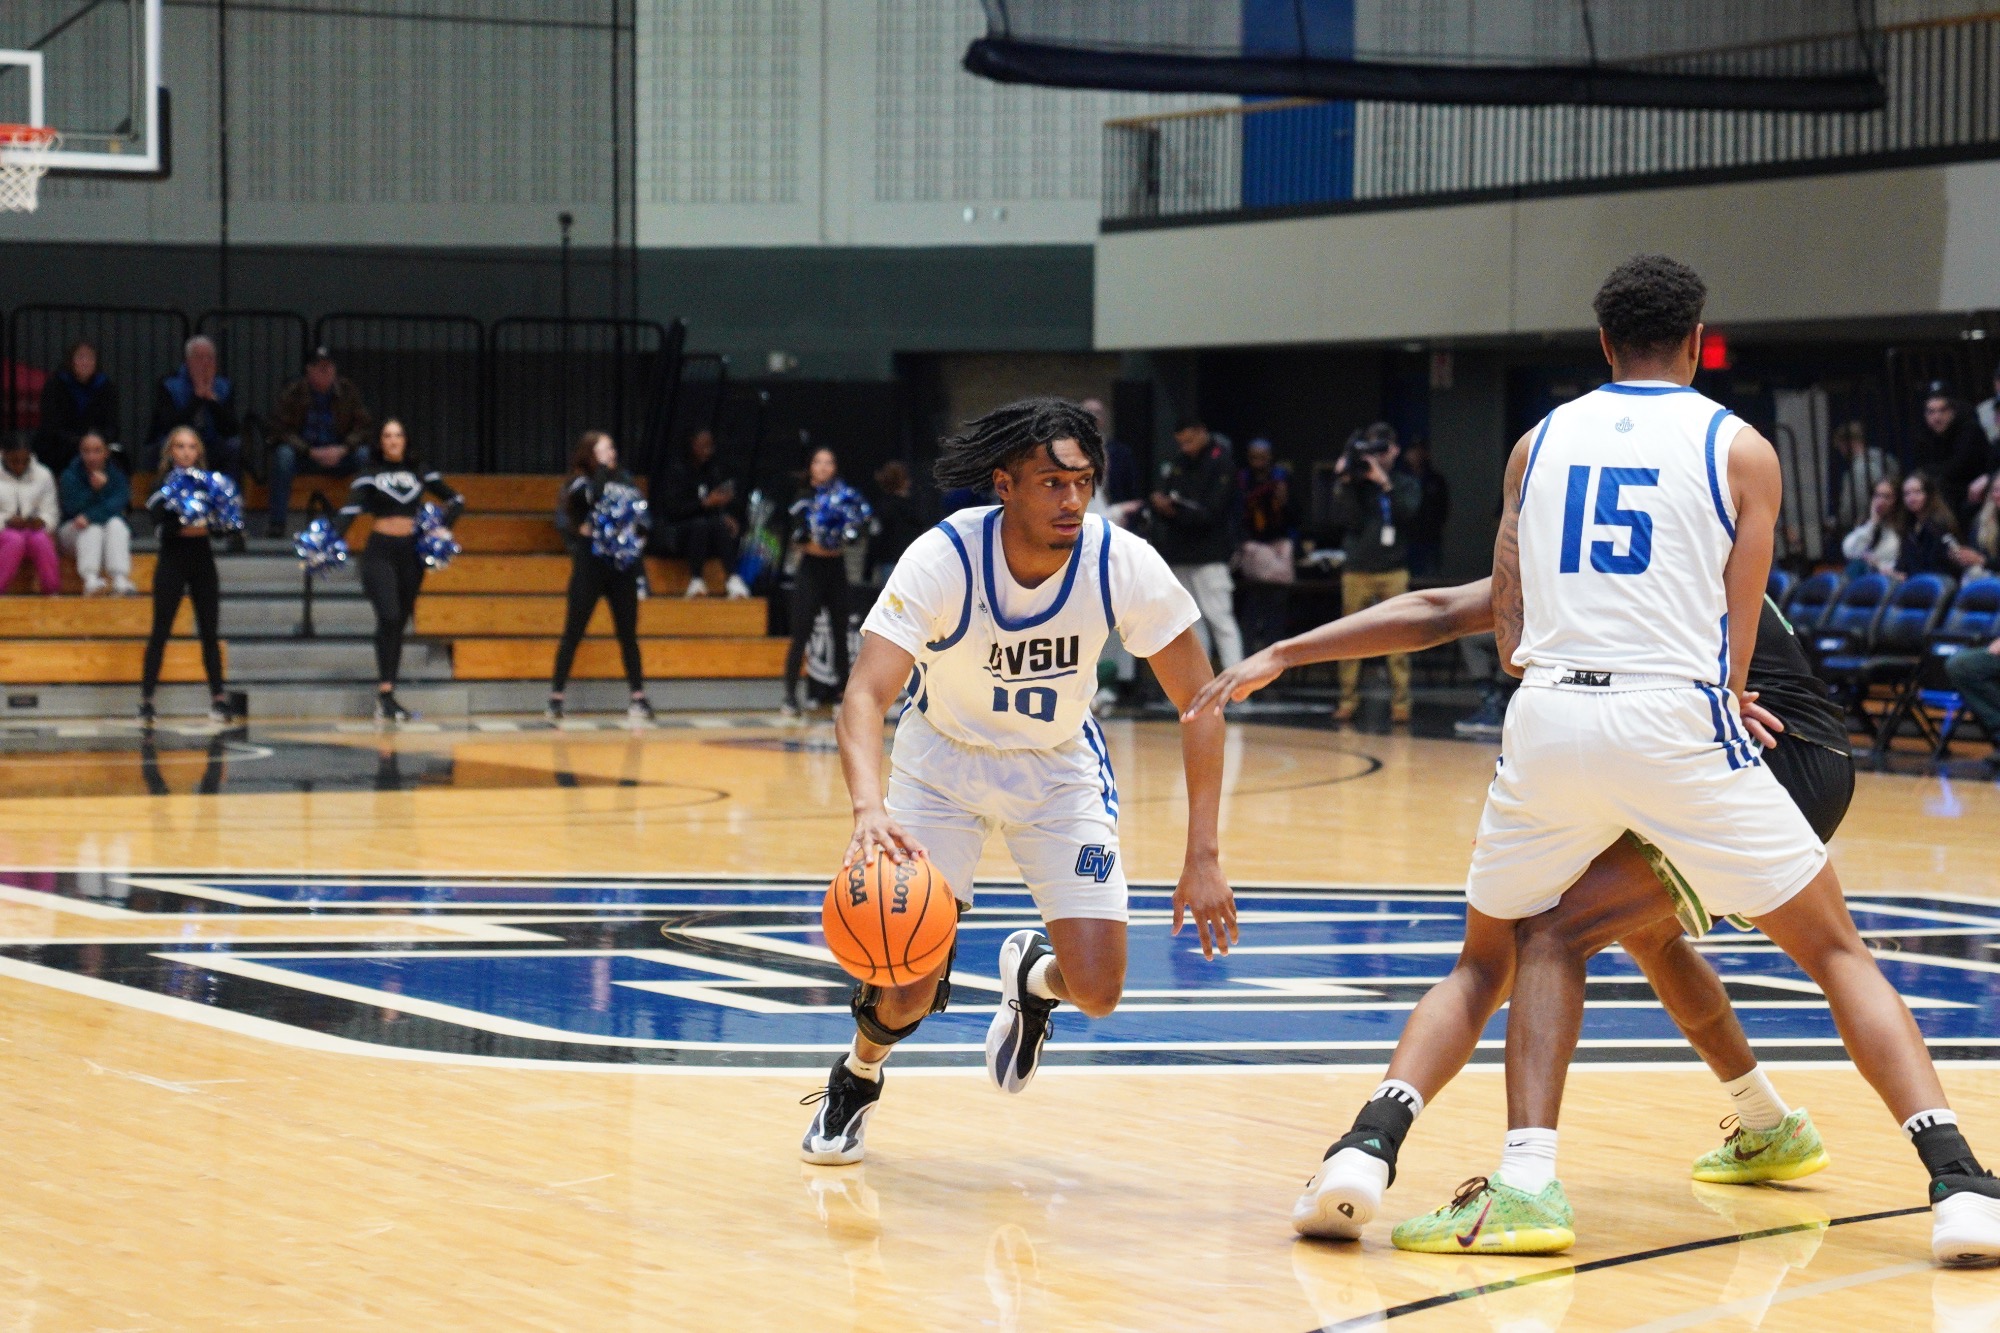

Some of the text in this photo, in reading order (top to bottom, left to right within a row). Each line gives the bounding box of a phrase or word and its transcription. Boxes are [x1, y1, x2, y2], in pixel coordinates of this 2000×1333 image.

[1559, 464, 1660, 574] 15
[992, 686, 1058, 722] 10
[1075, 844, 1116, 883] GV
